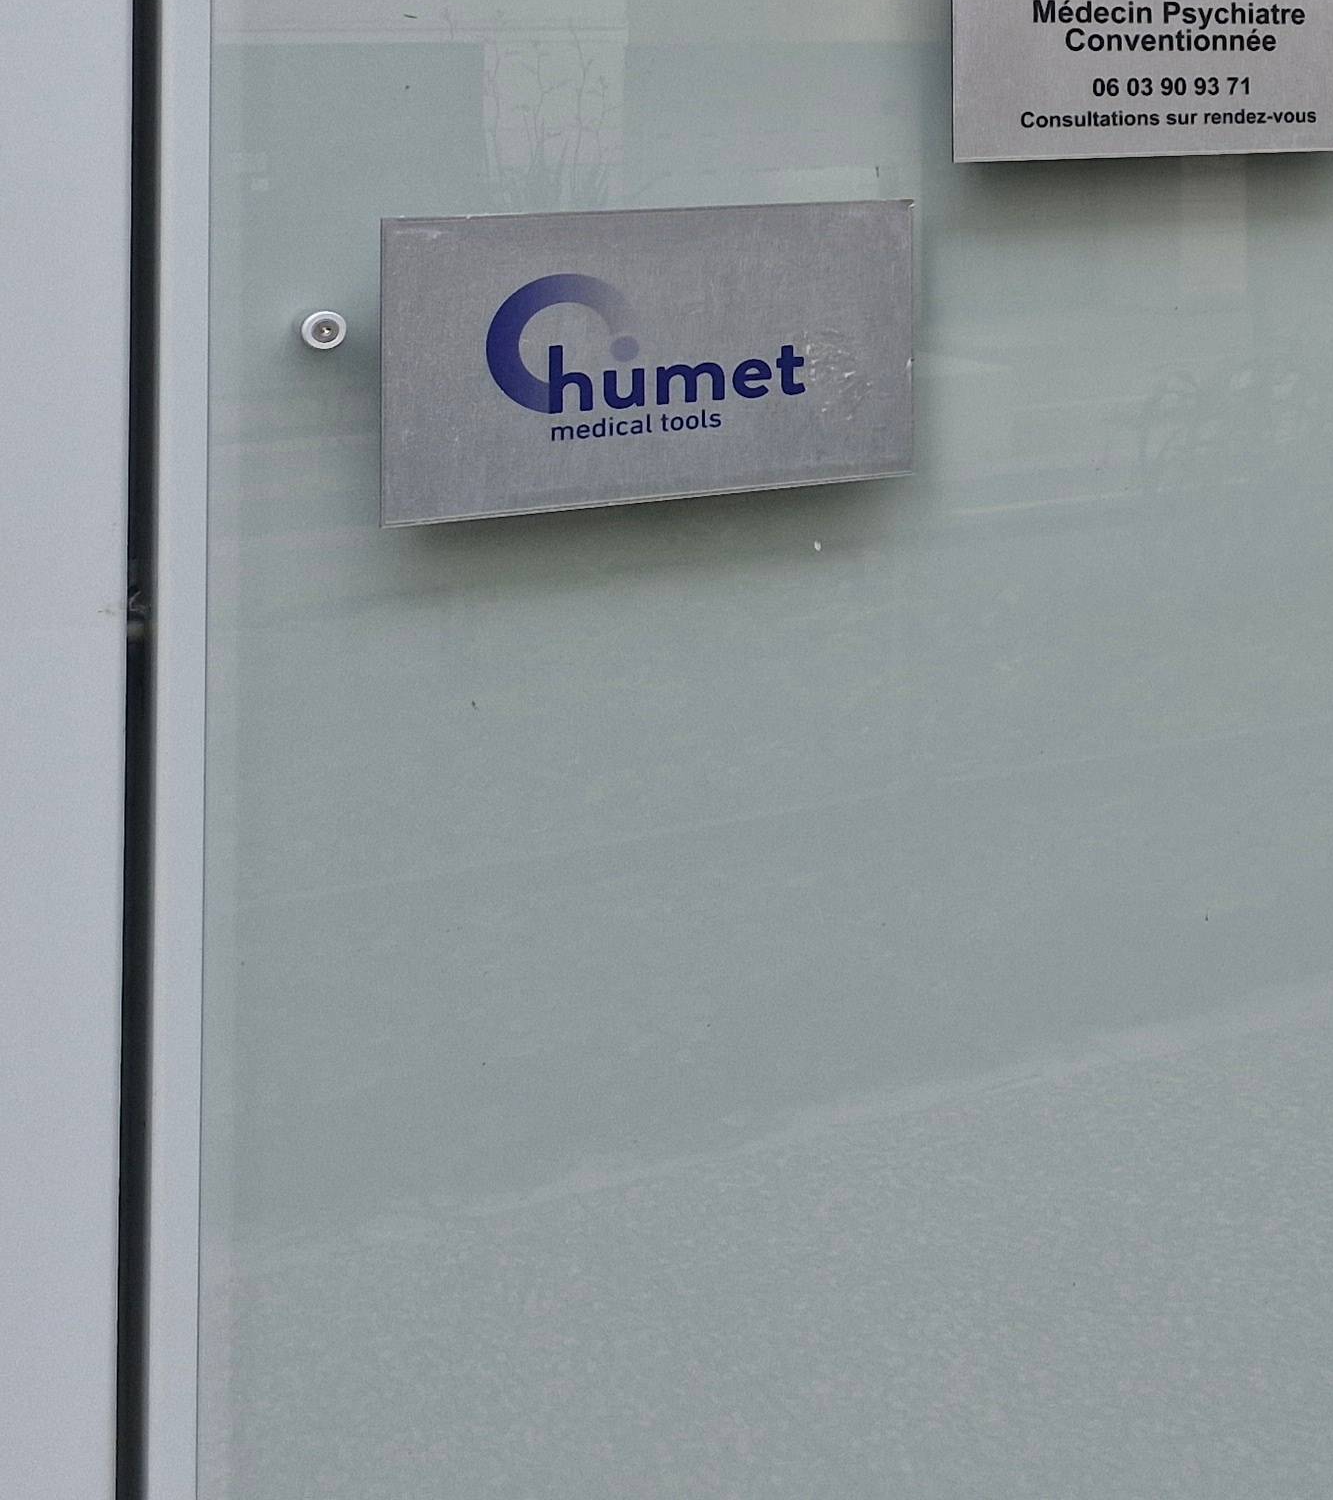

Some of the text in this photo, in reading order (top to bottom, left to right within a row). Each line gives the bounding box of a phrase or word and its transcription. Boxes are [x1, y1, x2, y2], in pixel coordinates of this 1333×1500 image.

[1033, 0, 1305, 30] Médecin Psychiatre
[1066, 28, 1276, 51] Conventionnée
[1093, 77, 1249, 96] 06 03 90 93 71
[1021, 109, 1316, 128] Consultations sur rendez-vous
[551, 409, 721, 441] medical tools
